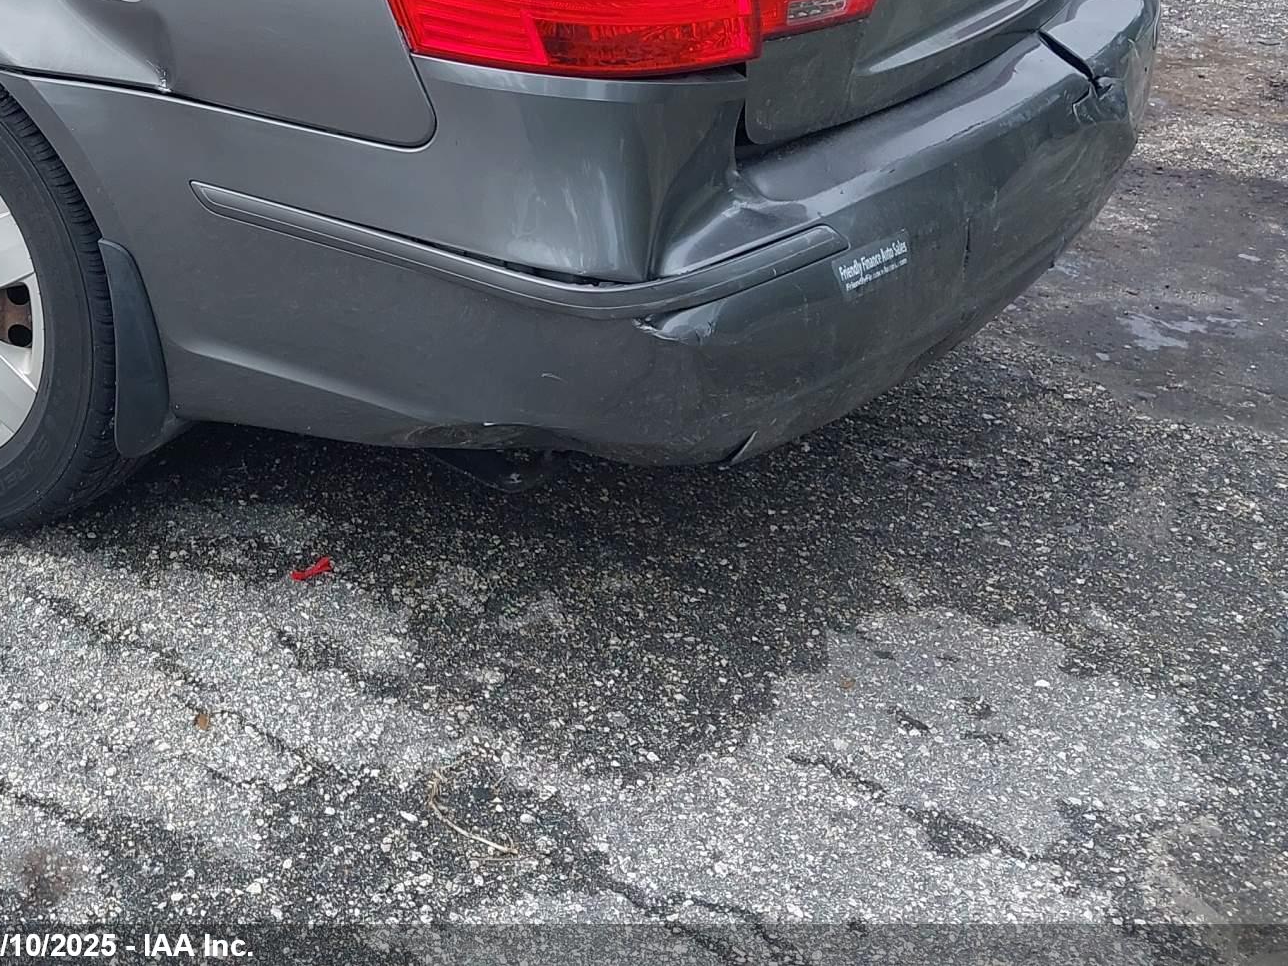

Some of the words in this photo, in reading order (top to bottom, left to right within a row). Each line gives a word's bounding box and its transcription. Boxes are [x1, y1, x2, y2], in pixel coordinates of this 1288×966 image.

[838, 259, 863, 281] Friendly
[860, 254, 881, 271] Finance
[880, 247, 894, 262] Auto
